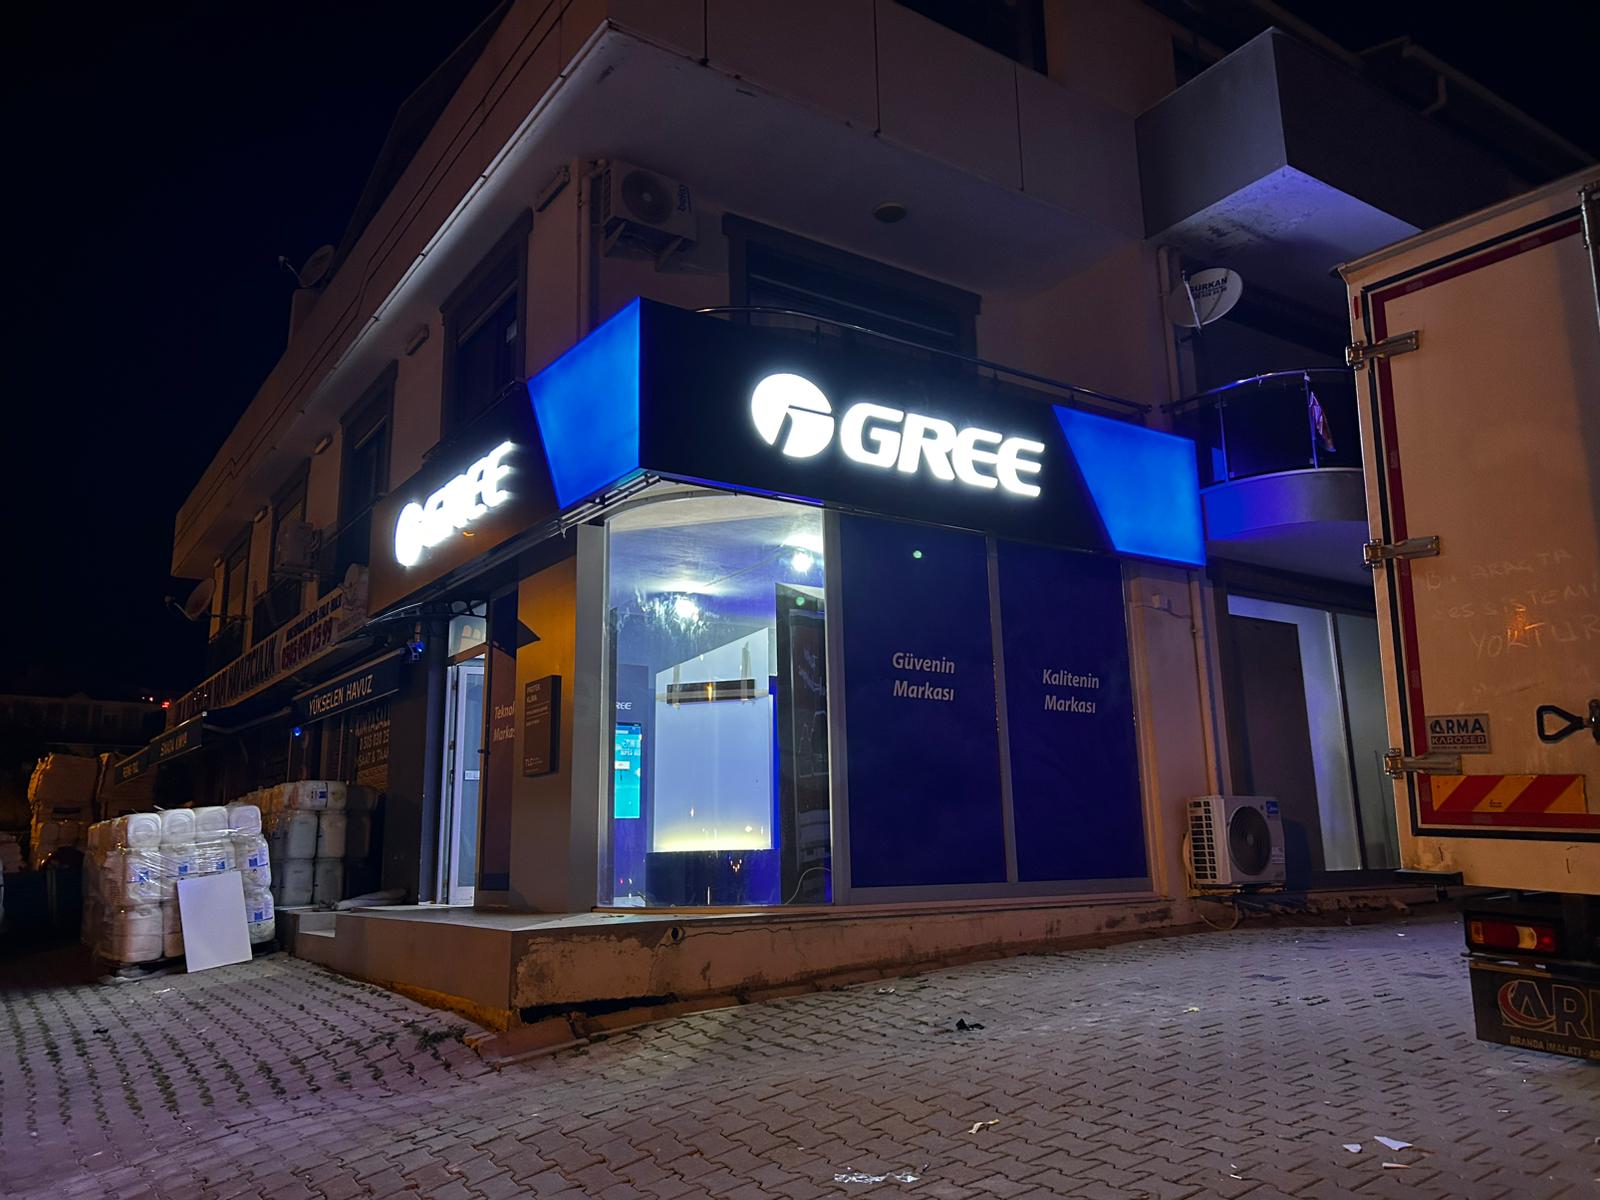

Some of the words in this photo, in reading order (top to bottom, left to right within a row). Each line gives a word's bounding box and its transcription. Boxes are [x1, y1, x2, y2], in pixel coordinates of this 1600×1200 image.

[840, 402, 1046, 498] GREE
[892, 652, 956, 675] Güvenin
[346, 673, 374, 702] HAVUZ
[1042, 668, 1100, 689] Kalitenin
[892, 680, 955, 702] Markası
[1044, 694, 1097, 714] Markası
[1430, 718, 1486, 734] ARMA
[1498, 978, 1600, 1043] AR
